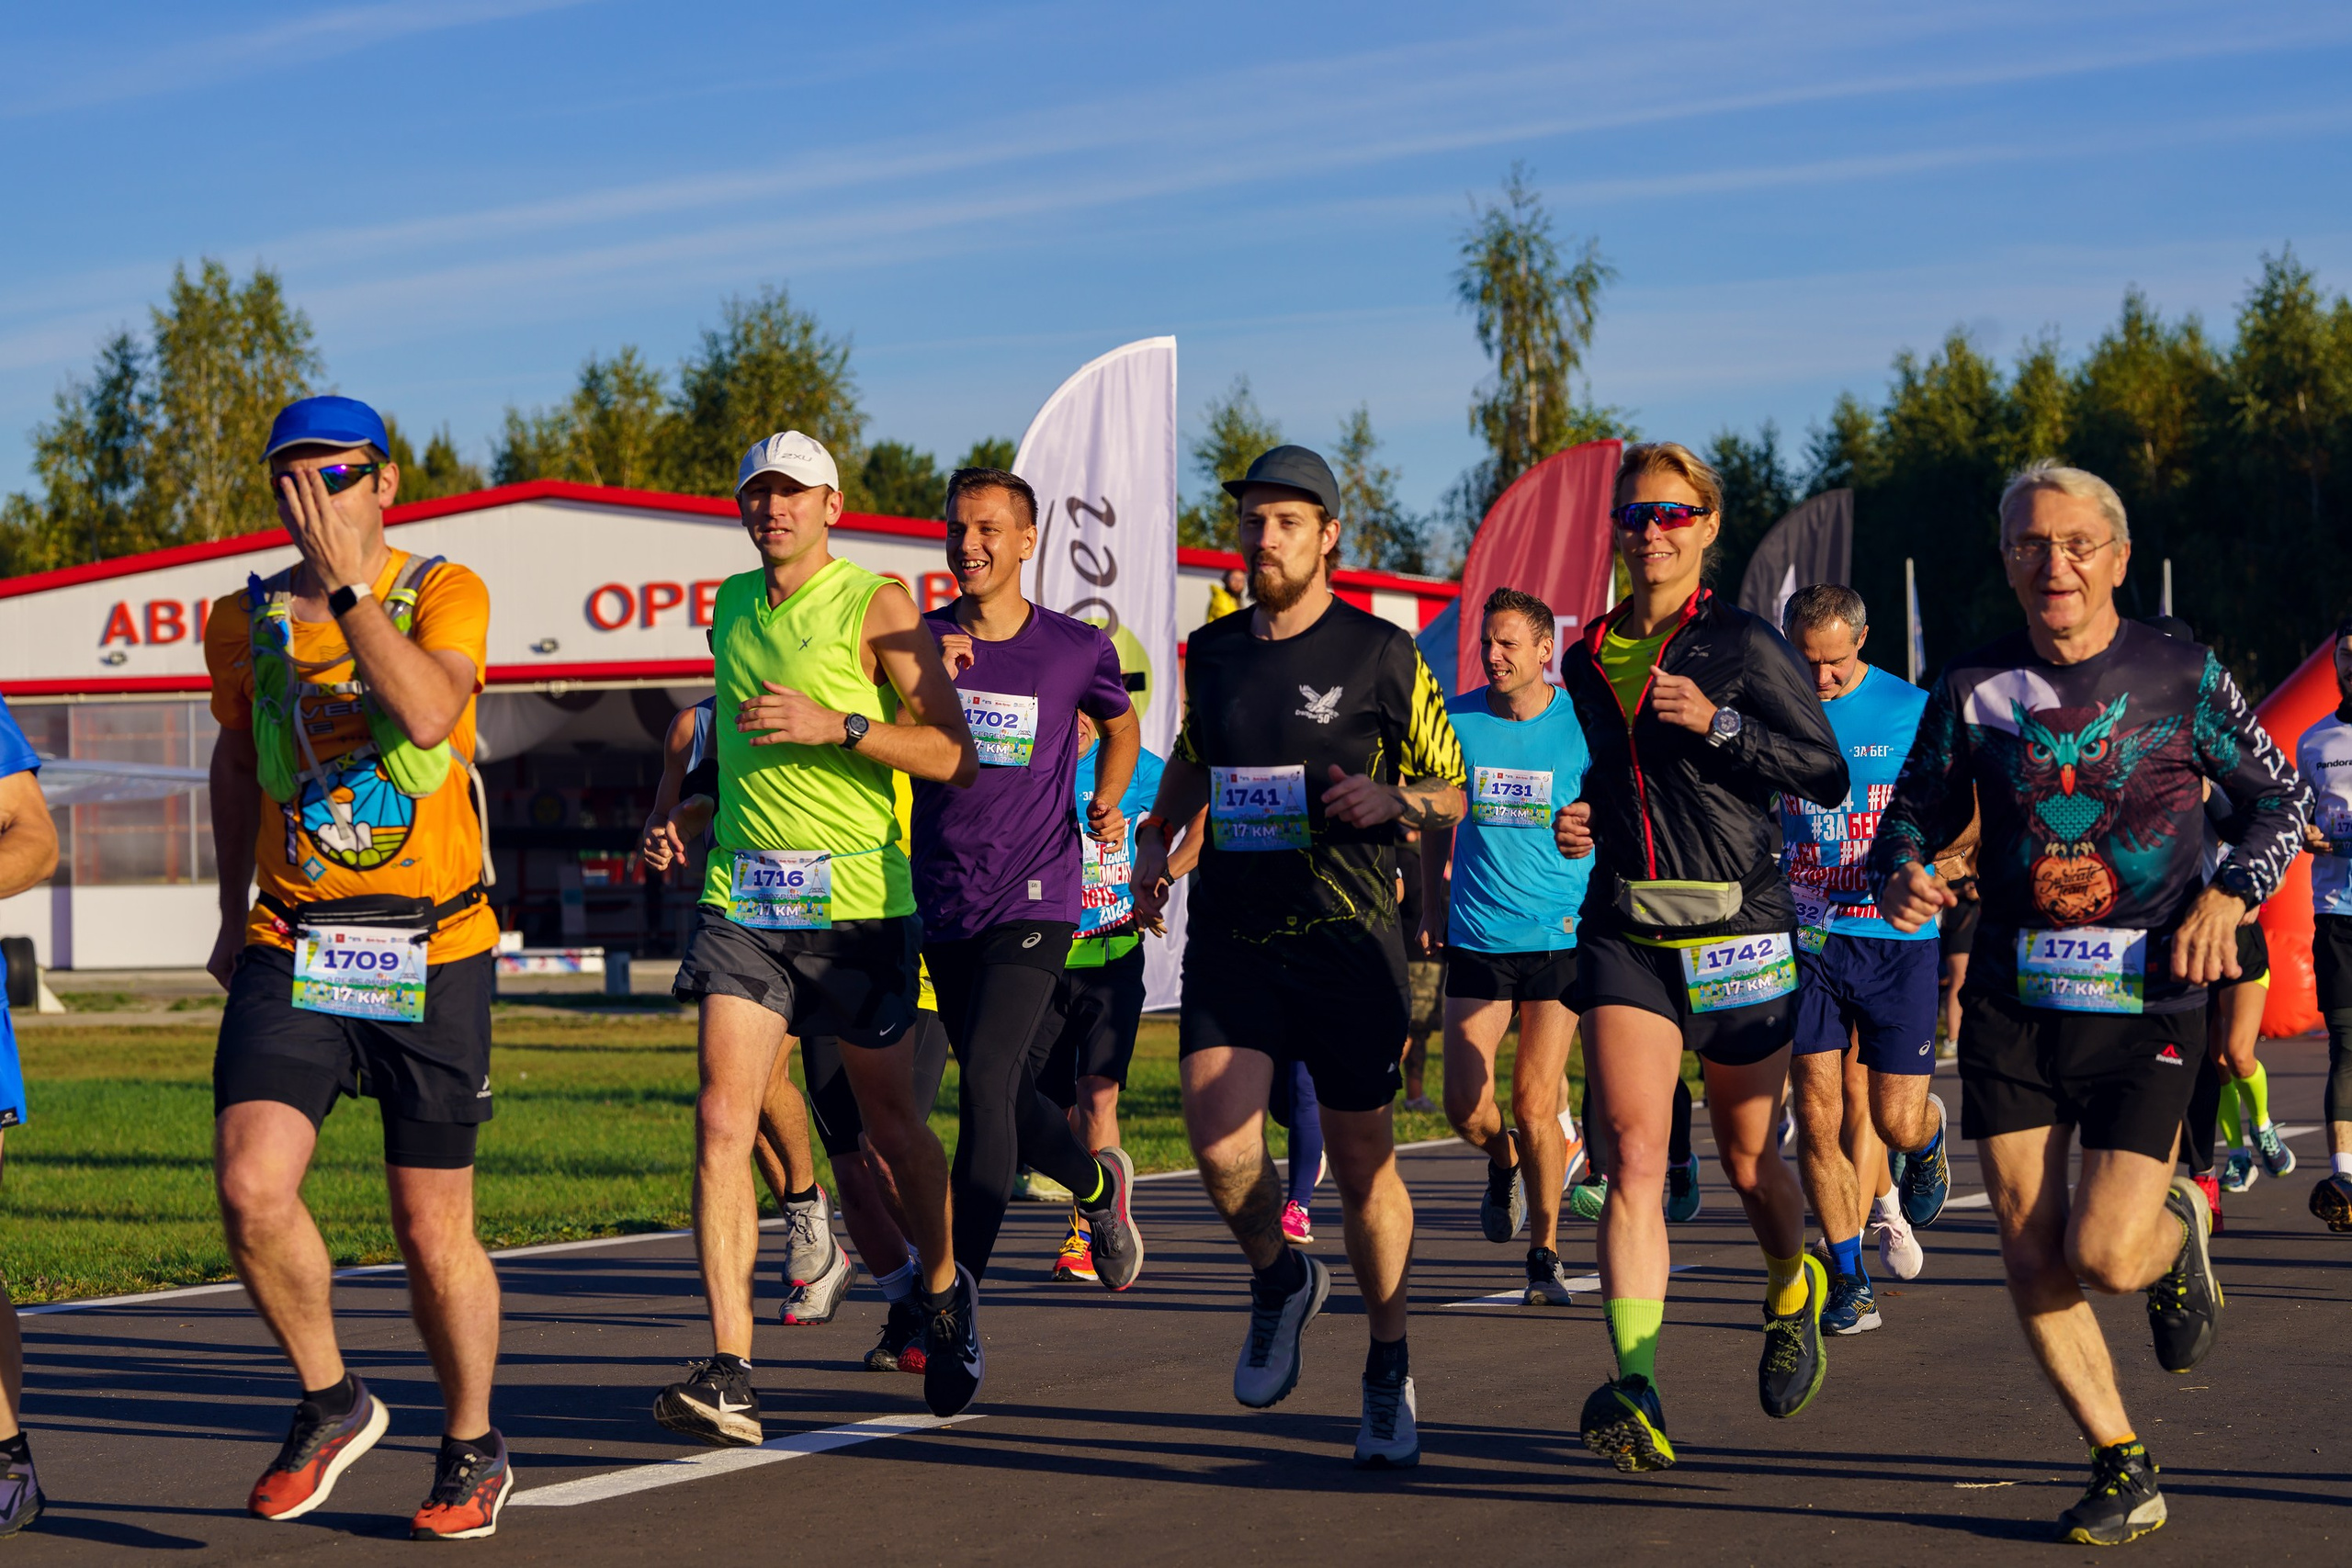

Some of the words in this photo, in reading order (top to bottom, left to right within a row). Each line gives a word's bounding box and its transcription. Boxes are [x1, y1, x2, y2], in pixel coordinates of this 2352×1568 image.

[964, 708, 1019, 729] 1702
[972, 730, 1006, 739] СЕРГЕЙ
[986, 744, 1007, 754] КМ
[1226, 788, 1281, 807] 1741
[1491, 783, 1532, 797] 1731
[1494, 806, 1507, 817] 17
[1510, 809, 1527, 818] КМ
[1232, 823, 1248, 838] 17
[1252, 826, 1275, 837] КМ
[753, 870, 805, 887] 1716
[758, 902, 772, 916] 17
[775, 906, 798, 917] КМ
[1795, 902, 1819, 919] 32
[1707, 939, 1773, 968] 1742
[2044, 939, 2113, 962] 1714
[323, 949, 399, 971] 1709
[1723, 980, 1740, 996] 17
[1747, 976, 1770, 991] КМ
[2051, 978, 2070, 995] 17
[2075, 983, 2104, 997] КМ
[332, 986, 353, 1002] 17
[357, 992, 386, 1005] КМ
